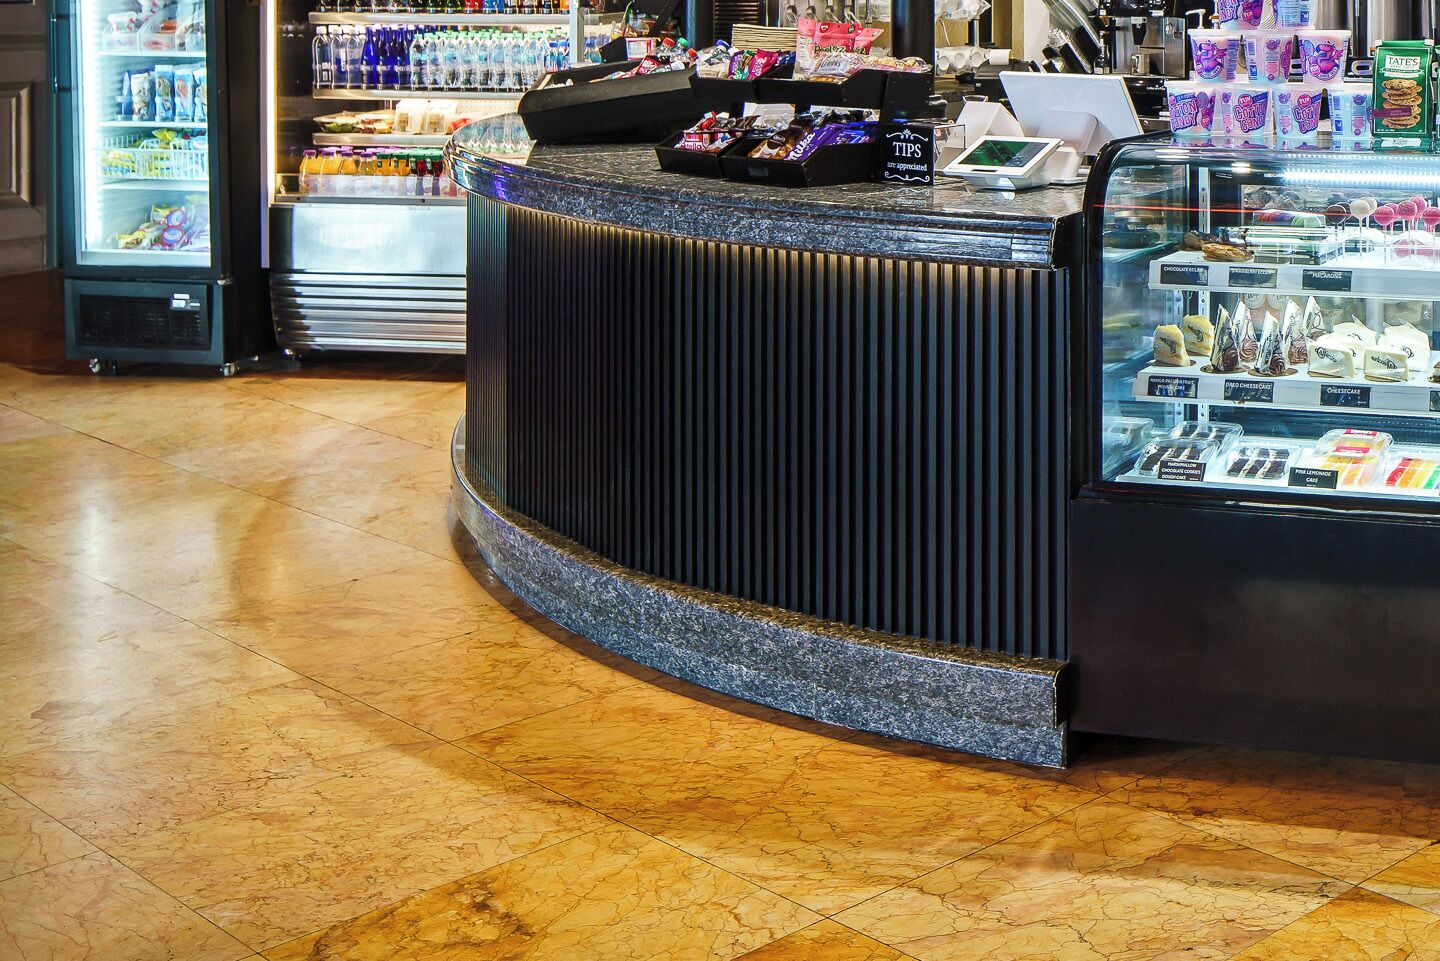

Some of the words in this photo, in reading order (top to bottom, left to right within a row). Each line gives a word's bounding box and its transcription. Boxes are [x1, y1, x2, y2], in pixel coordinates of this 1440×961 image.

[1387, 57, 1418, 67] TATE'S
[783, 131, 815, 161] Milka
[893, 142, 921, 157] TIPS
[897, 161, 928, 172] appreciated
